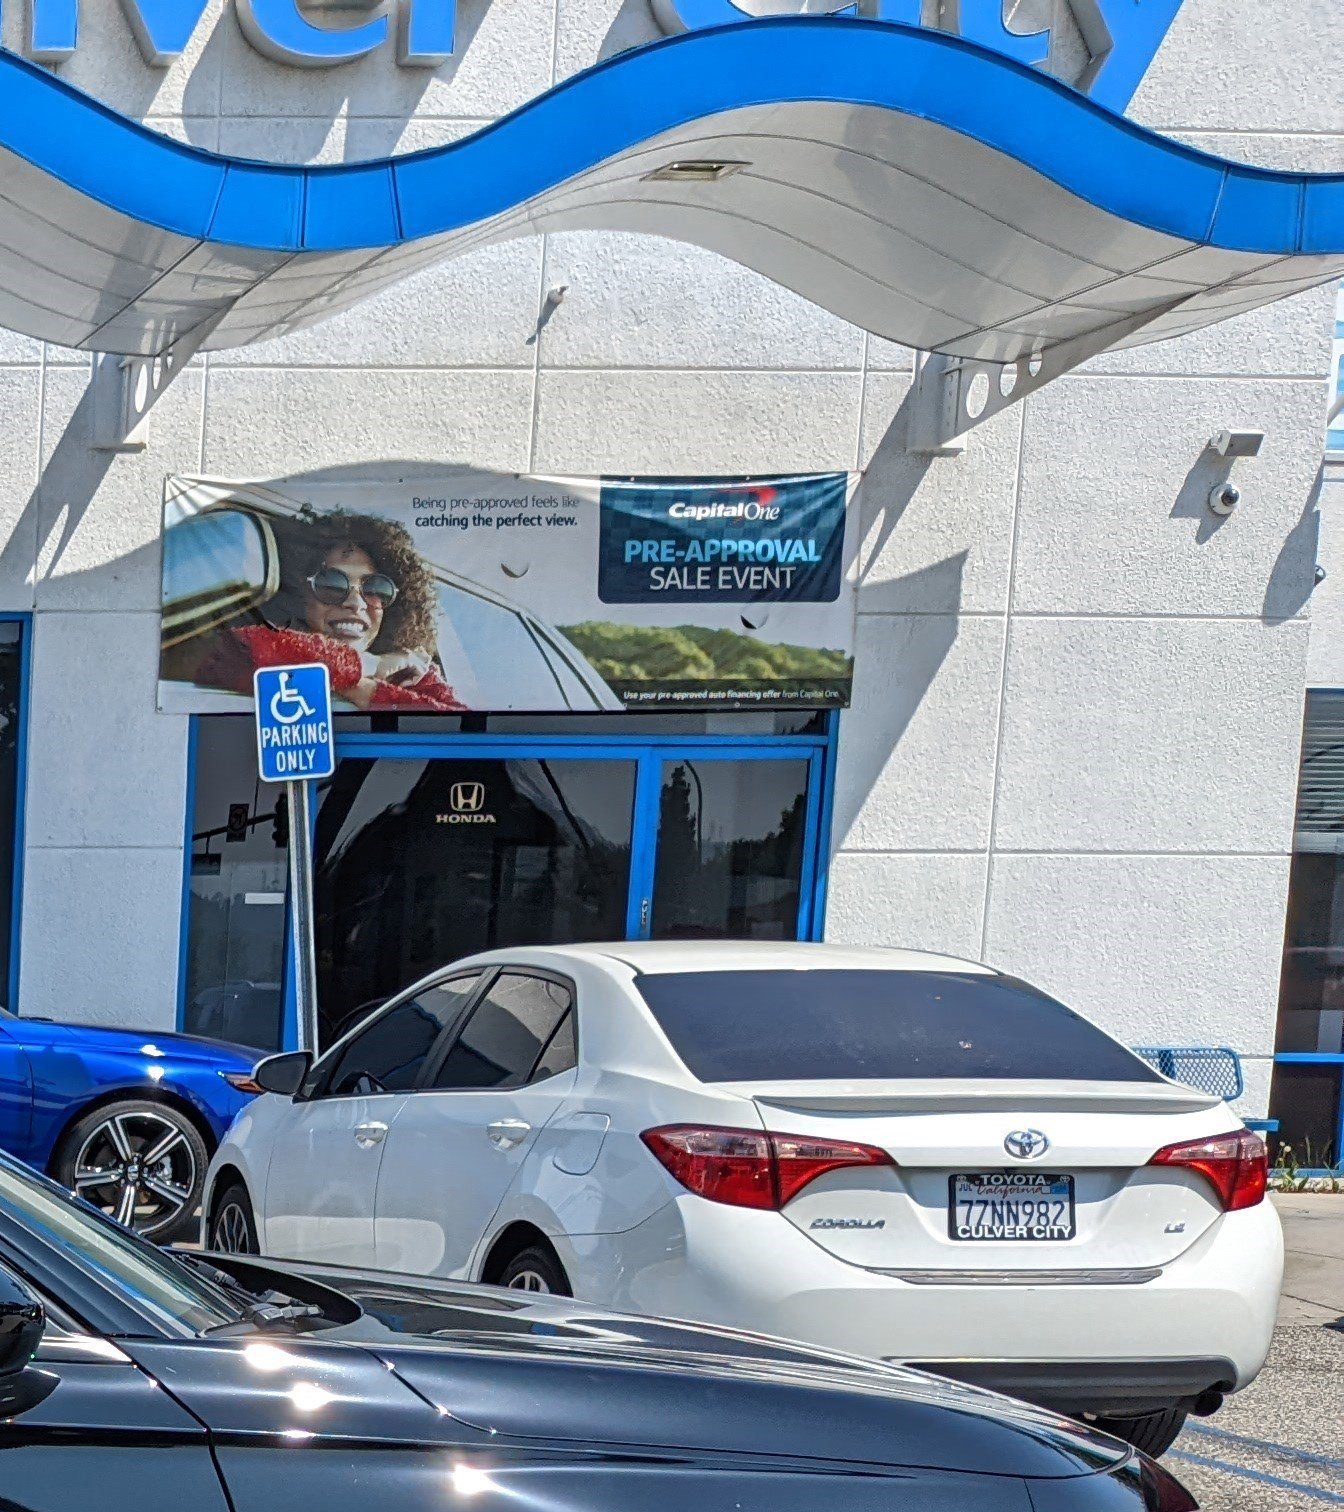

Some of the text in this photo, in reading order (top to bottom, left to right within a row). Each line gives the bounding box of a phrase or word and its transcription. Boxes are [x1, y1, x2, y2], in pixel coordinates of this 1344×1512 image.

[412, 496, 579, 511] Being pre-approved feels like
[415, 513, 578, 530] catching the perfect view.
[624, 539, 822, 563] PRE-APPROVAL
[649, 566, 797, 590] SALE EVENT
[623, 691, 638, 700] Use
[639, 692, 656, 701] your
[708, 691, 726, 699] auto
[727, 689, 762, 700] financing
[762, 689, 781, 699] offer
[262, 722, 328, 748] PARKING
[276, 749, 316, 773] ONLY
[435, 815, 497, 824] HONDA
[980, 1174, 1047, 1186] TOYOTA
[959, 1199, 1066, 1228] 7ZNN982
[957, 1225, 1072, 1238] CULVER CITY
